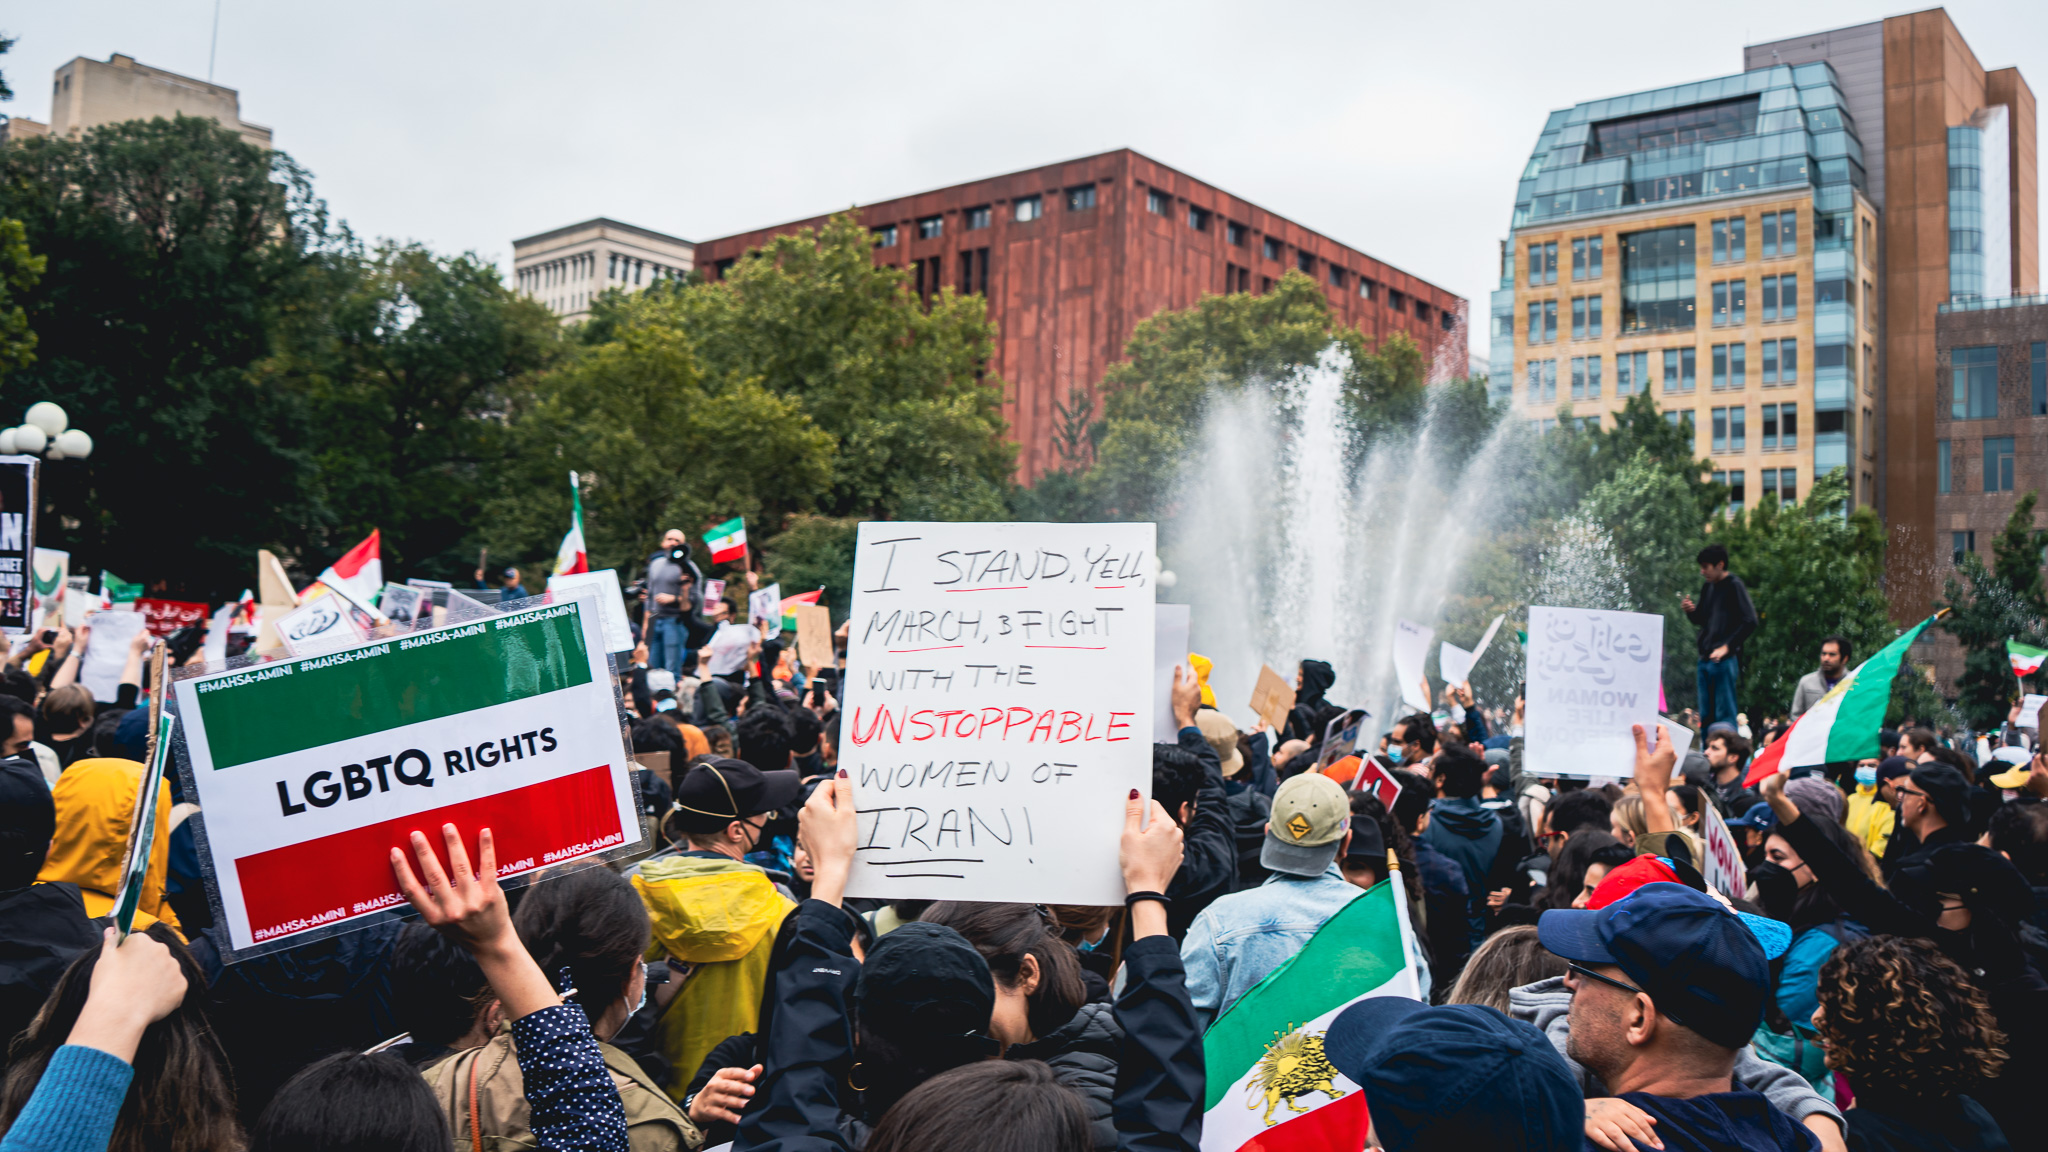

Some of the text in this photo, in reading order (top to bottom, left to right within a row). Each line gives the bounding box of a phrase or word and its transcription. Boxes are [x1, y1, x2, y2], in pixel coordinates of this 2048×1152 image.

[863, 537, 1147, 593] I STAND, YELL,
[199, 603, 577, 694] #MAHSA-AMINI #MAHSA-AMINI #MAHSA-AMINI #MAHSA-AMINI
[862, 609, 989, 646] MARCH,
[1017, 607, 1124, 638] FIGHT
[869, 663, 1037, 692] WITH THE
[851, 703, 1136, 747] UNSTOPPABLE
[276, 726, 558, 817] LGBTQ RIGHTS
[860, 760, 1078, 793] WOMEN OF
[856, 806, 1034, 864] IRAN!
[254, 907, 345, 941] #MAHSA-AMINI
[543, 832, 622, 864] #MAHSA-AMINI
